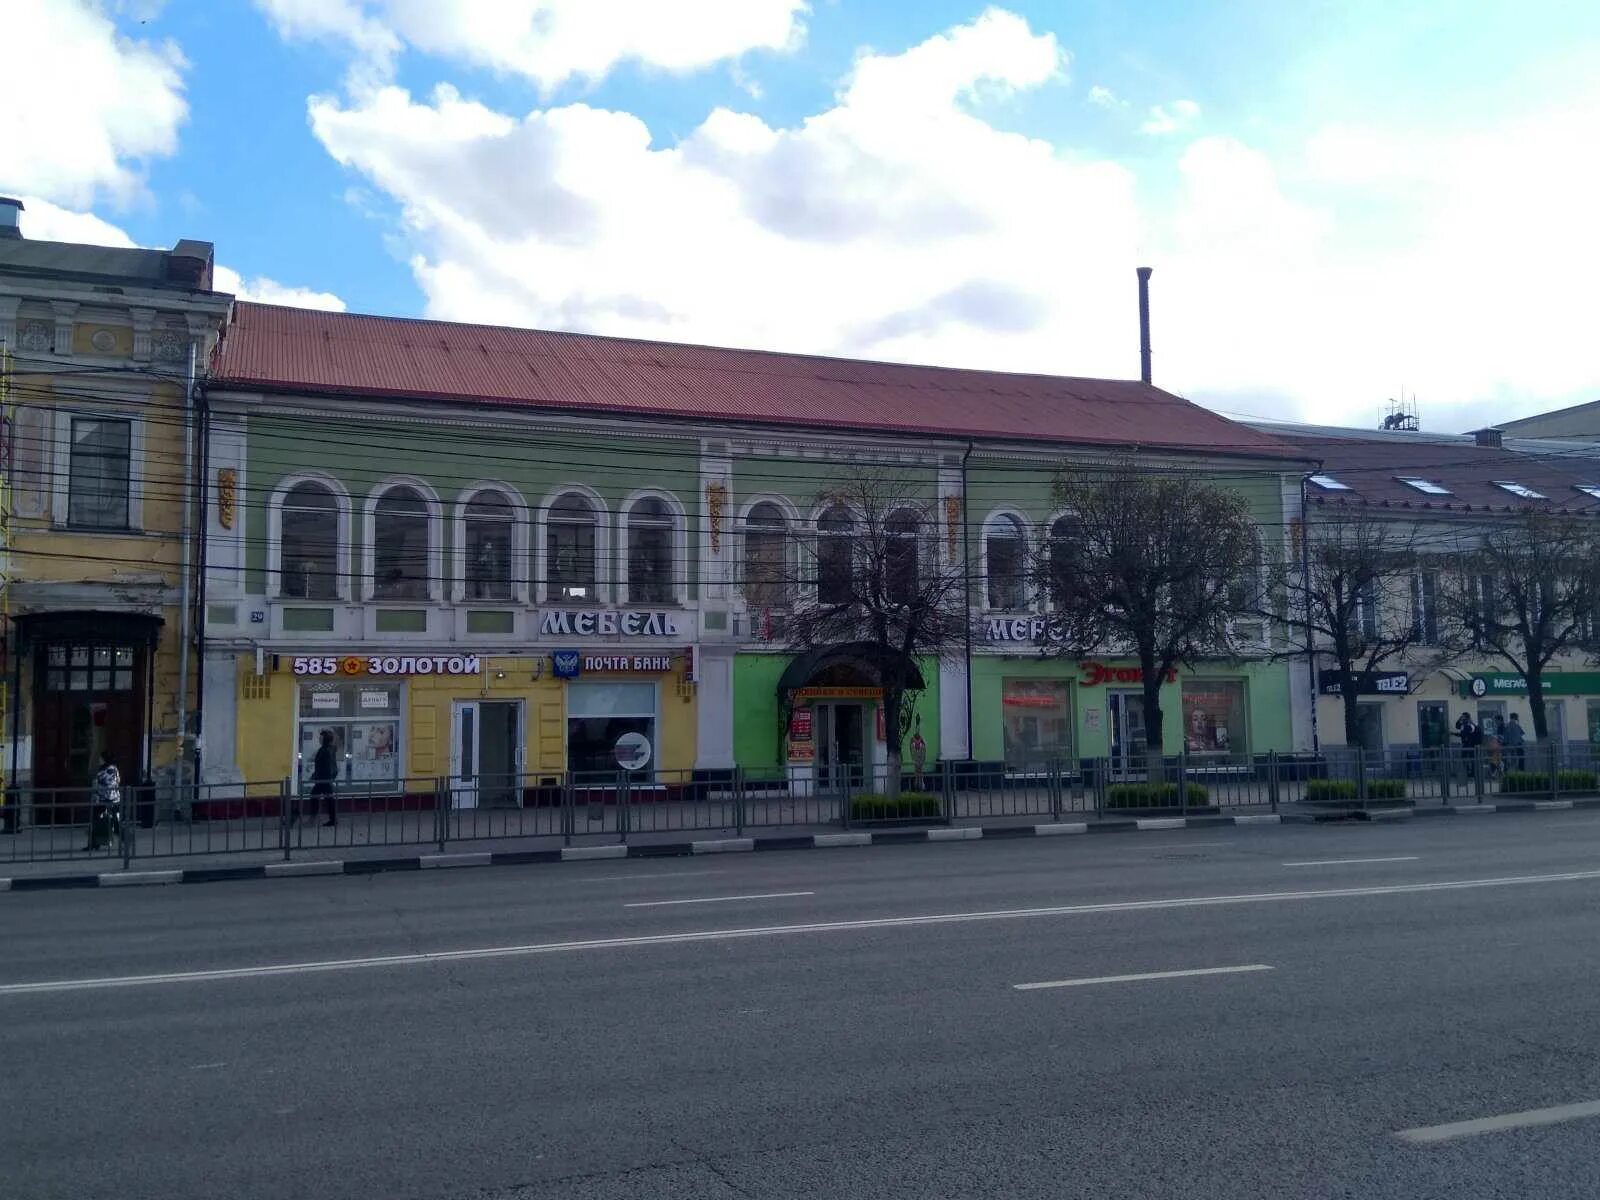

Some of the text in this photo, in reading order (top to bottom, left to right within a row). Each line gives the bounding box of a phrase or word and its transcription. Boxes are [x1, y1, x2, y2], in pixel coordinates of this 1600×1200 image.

[541, 609, 681, 635] МЕБЕЛЬ
[293, 654, 481, 675] 585 ЗОЛОТОЙ
[584, 656, 671, 671] ПОЧТА БАНК
[1375, 675, 1408, 691] TELE2
